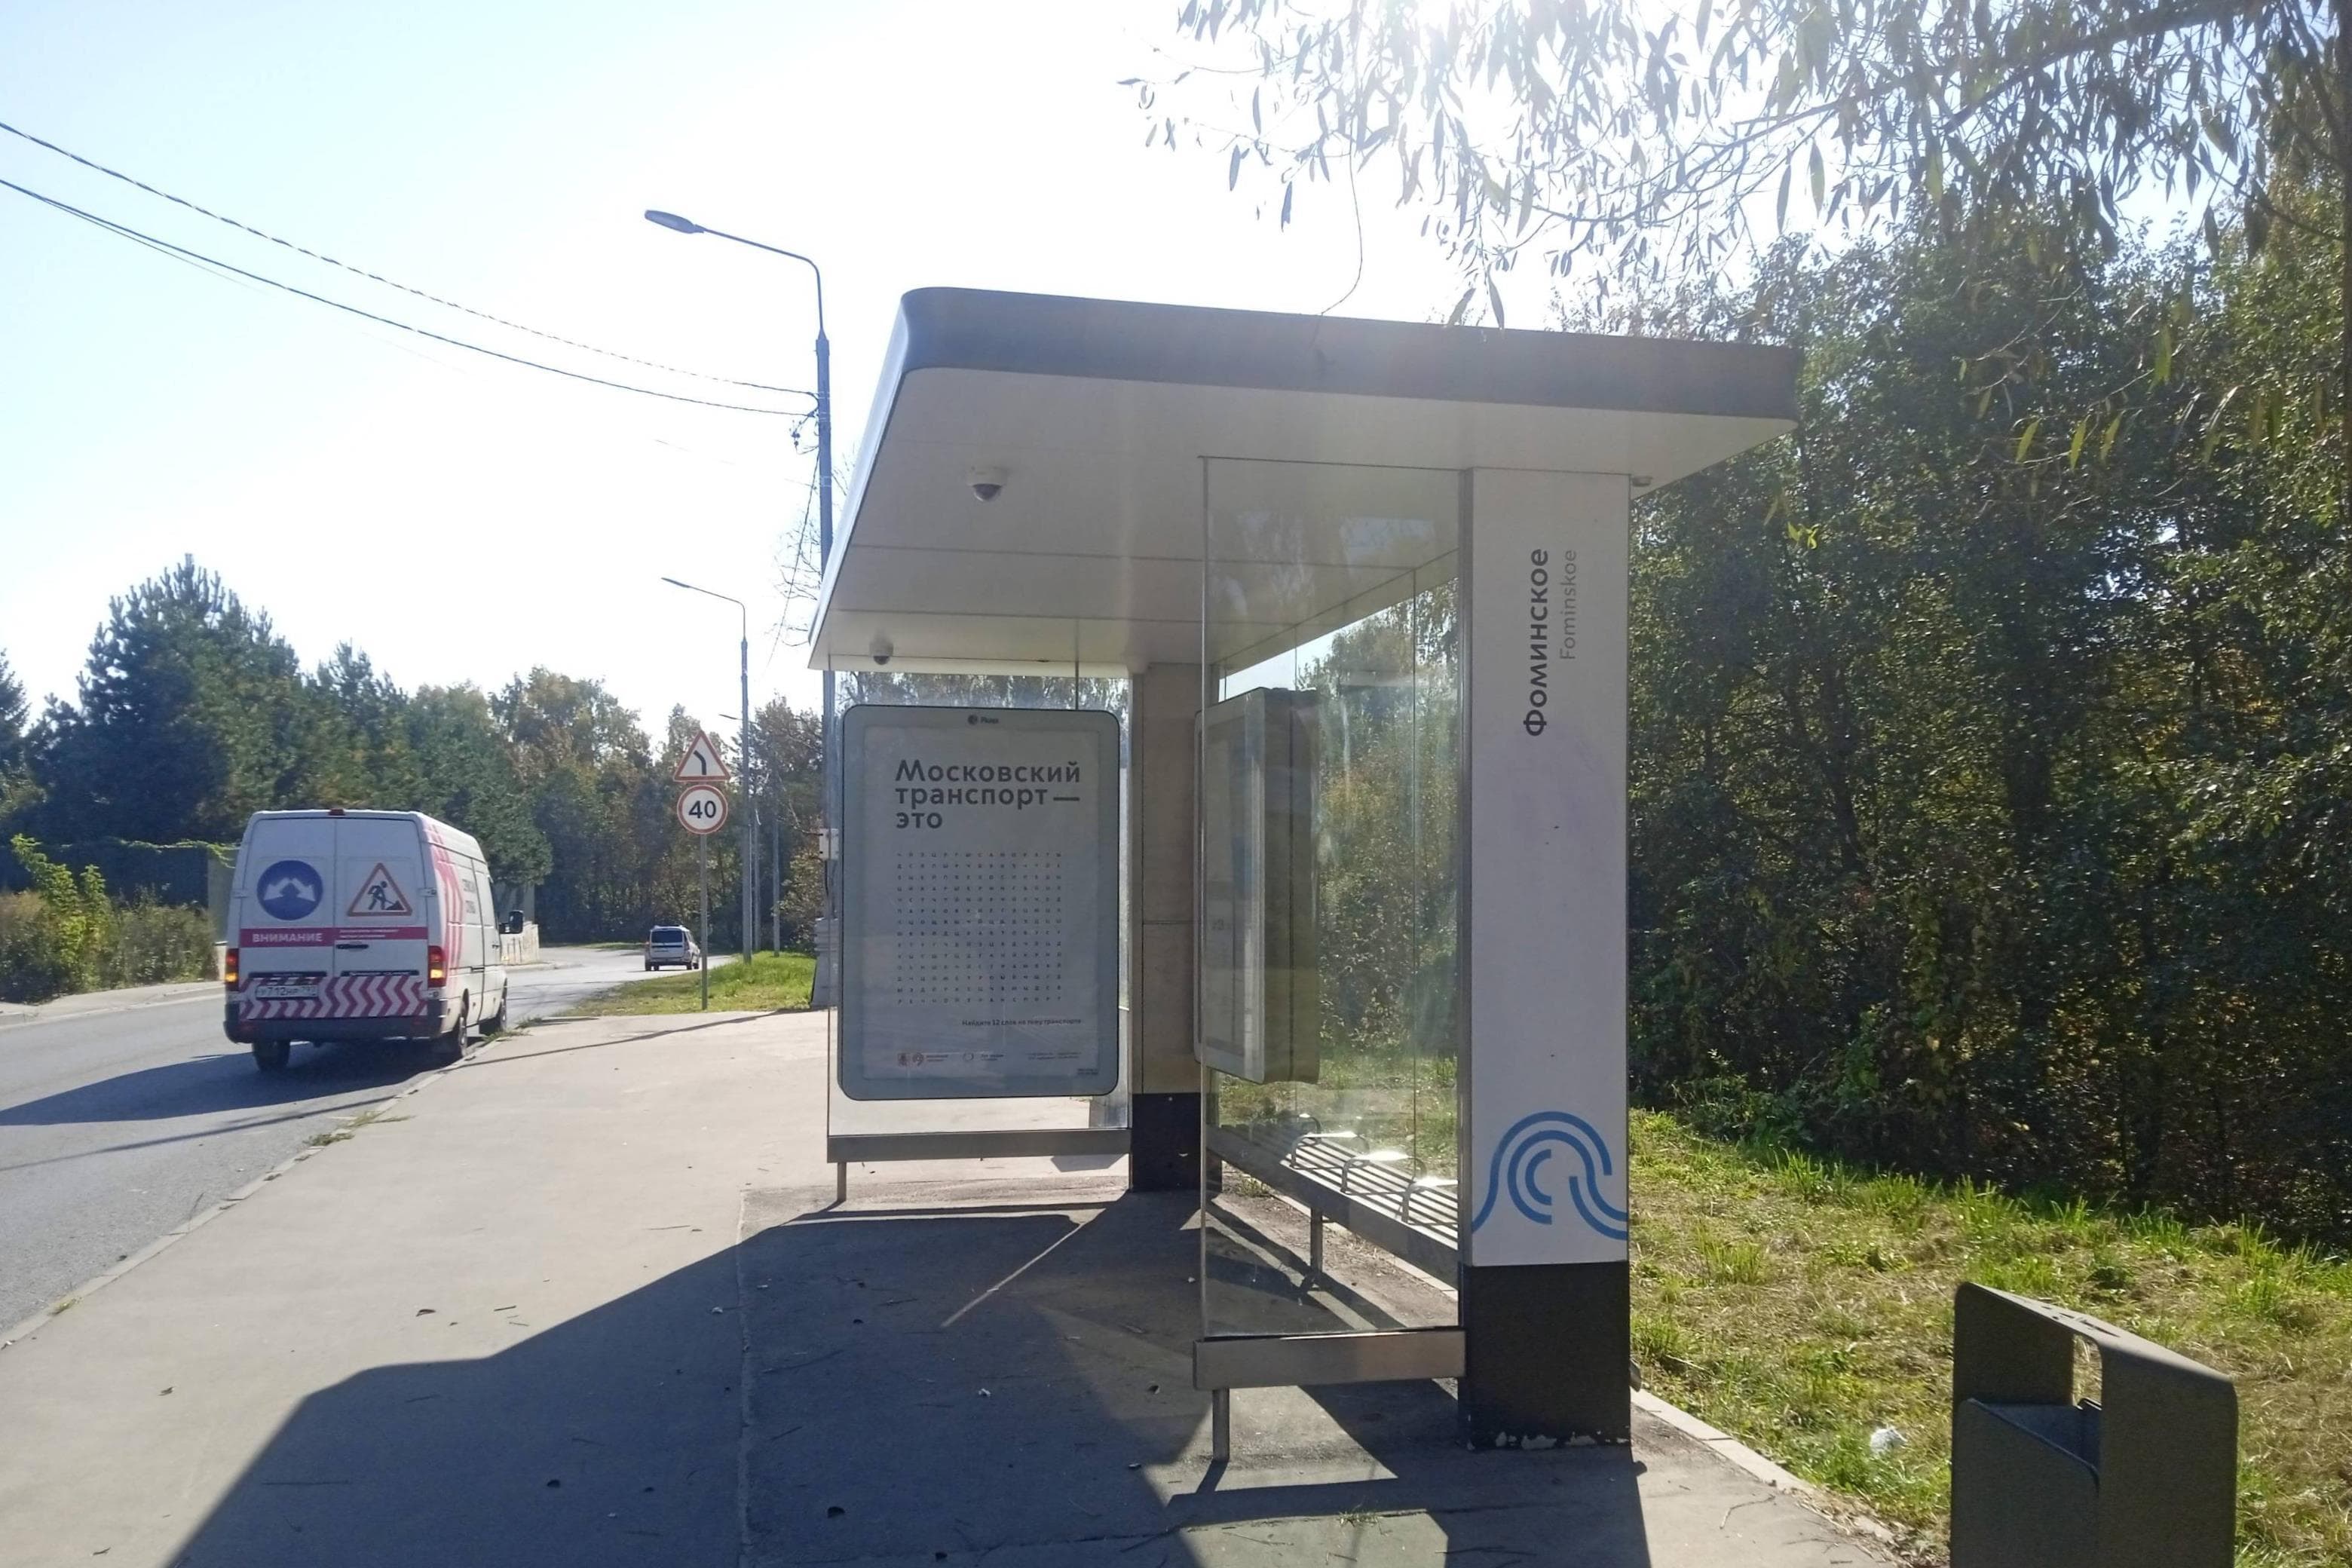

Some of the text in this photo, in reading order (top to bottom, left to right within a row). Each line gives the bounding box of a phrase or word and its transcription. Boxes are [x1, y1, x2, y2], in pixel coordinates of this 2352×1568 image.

[1560, 550, 1577, 660] Fominskoe
[1523, 549, 1548, 737] Фоминское
[895, 760, 1080, 782] Московский
[688, 800, 716, 819] 40
[895, 788, 1048, 810] транспорт
[896, 812, 943, 829] это
[252, 933, 323, 943] ВНИМАНИЕ
